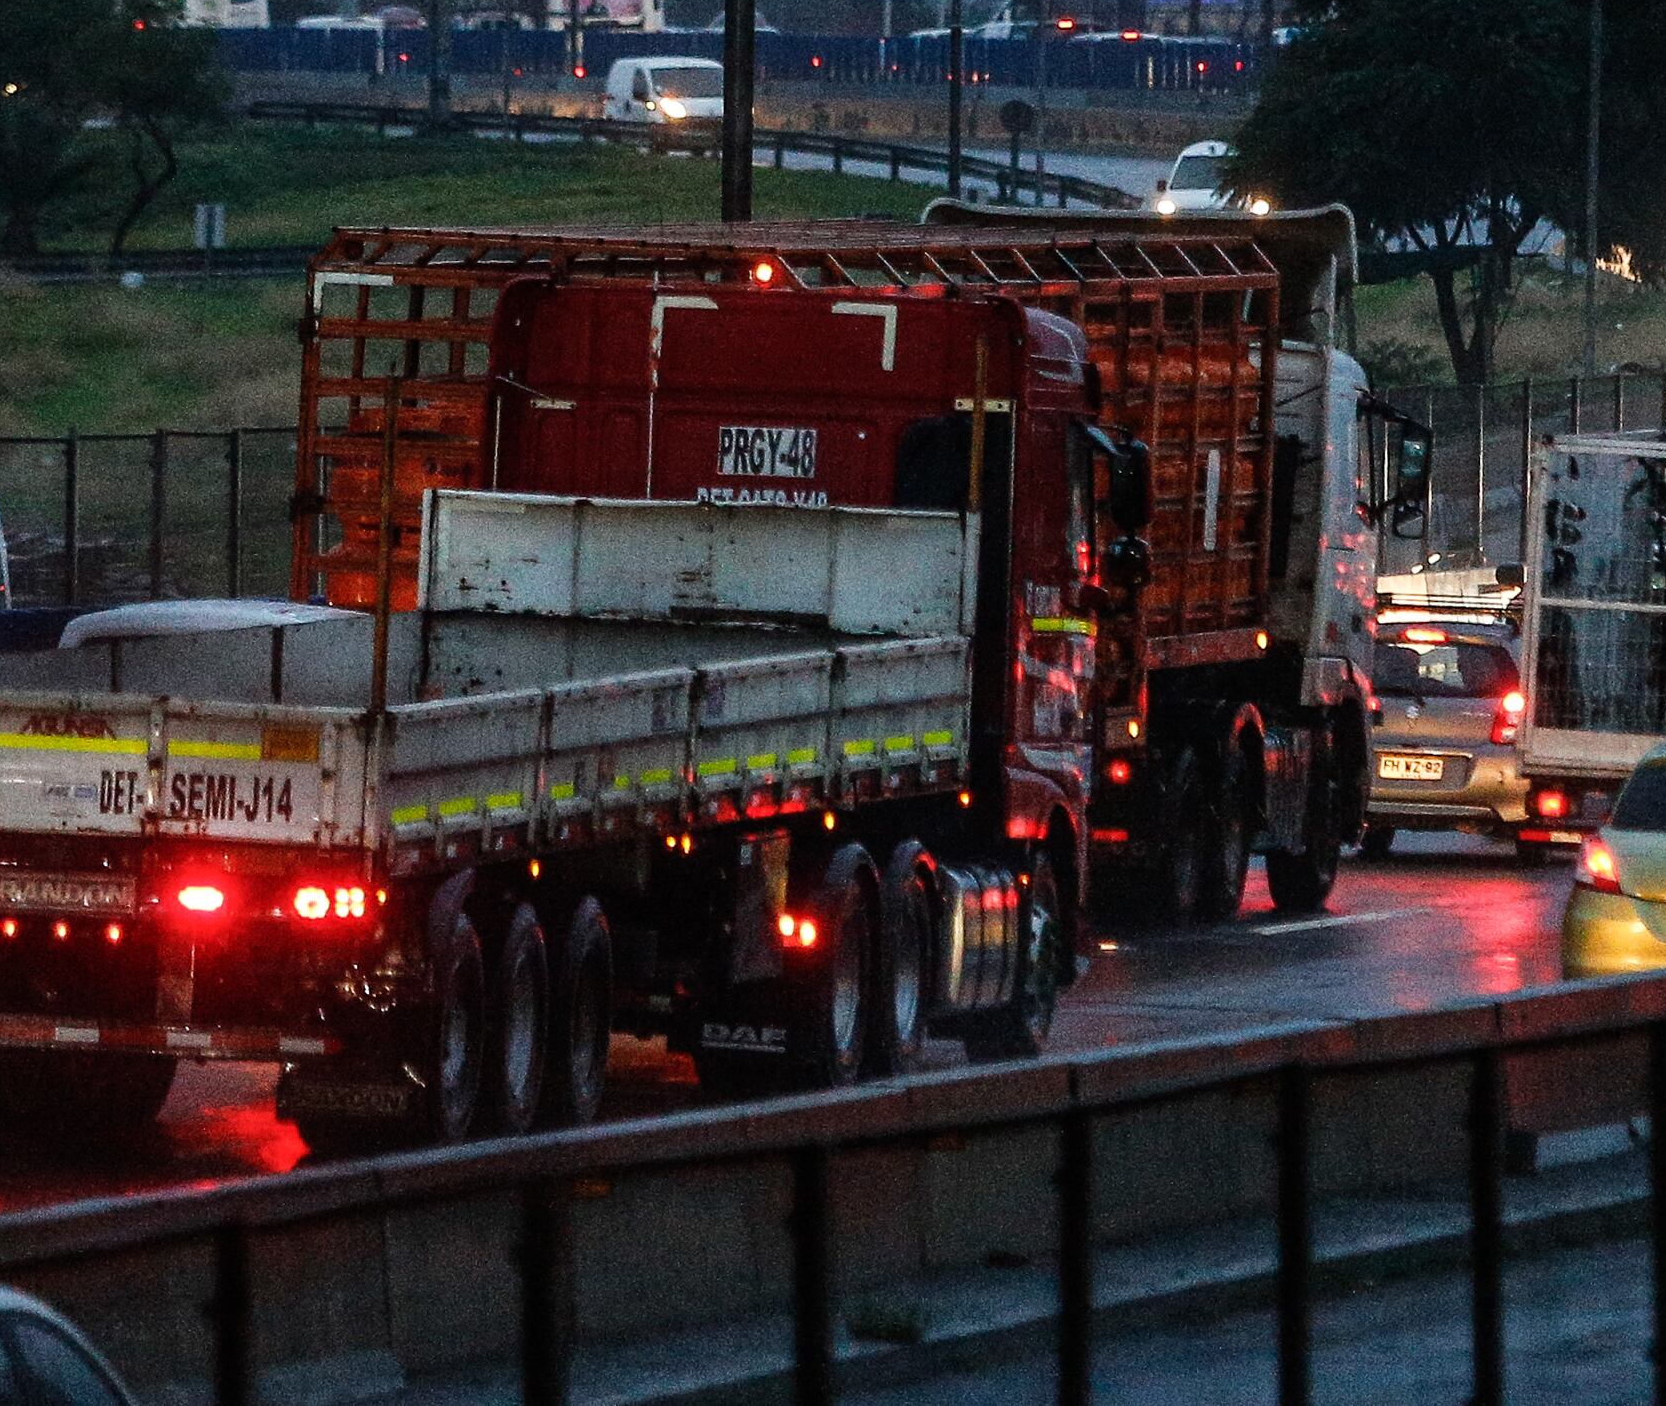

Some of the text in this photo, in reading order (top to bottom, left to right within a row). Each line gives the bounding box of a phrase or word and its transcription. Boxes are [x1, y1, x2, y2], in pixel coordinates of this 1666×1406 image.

[720, 428, 813, 476] PRGY-48
[169, 771, 293, 822] SEMI-J14
[701, 1022, 787, 1043] DAF
